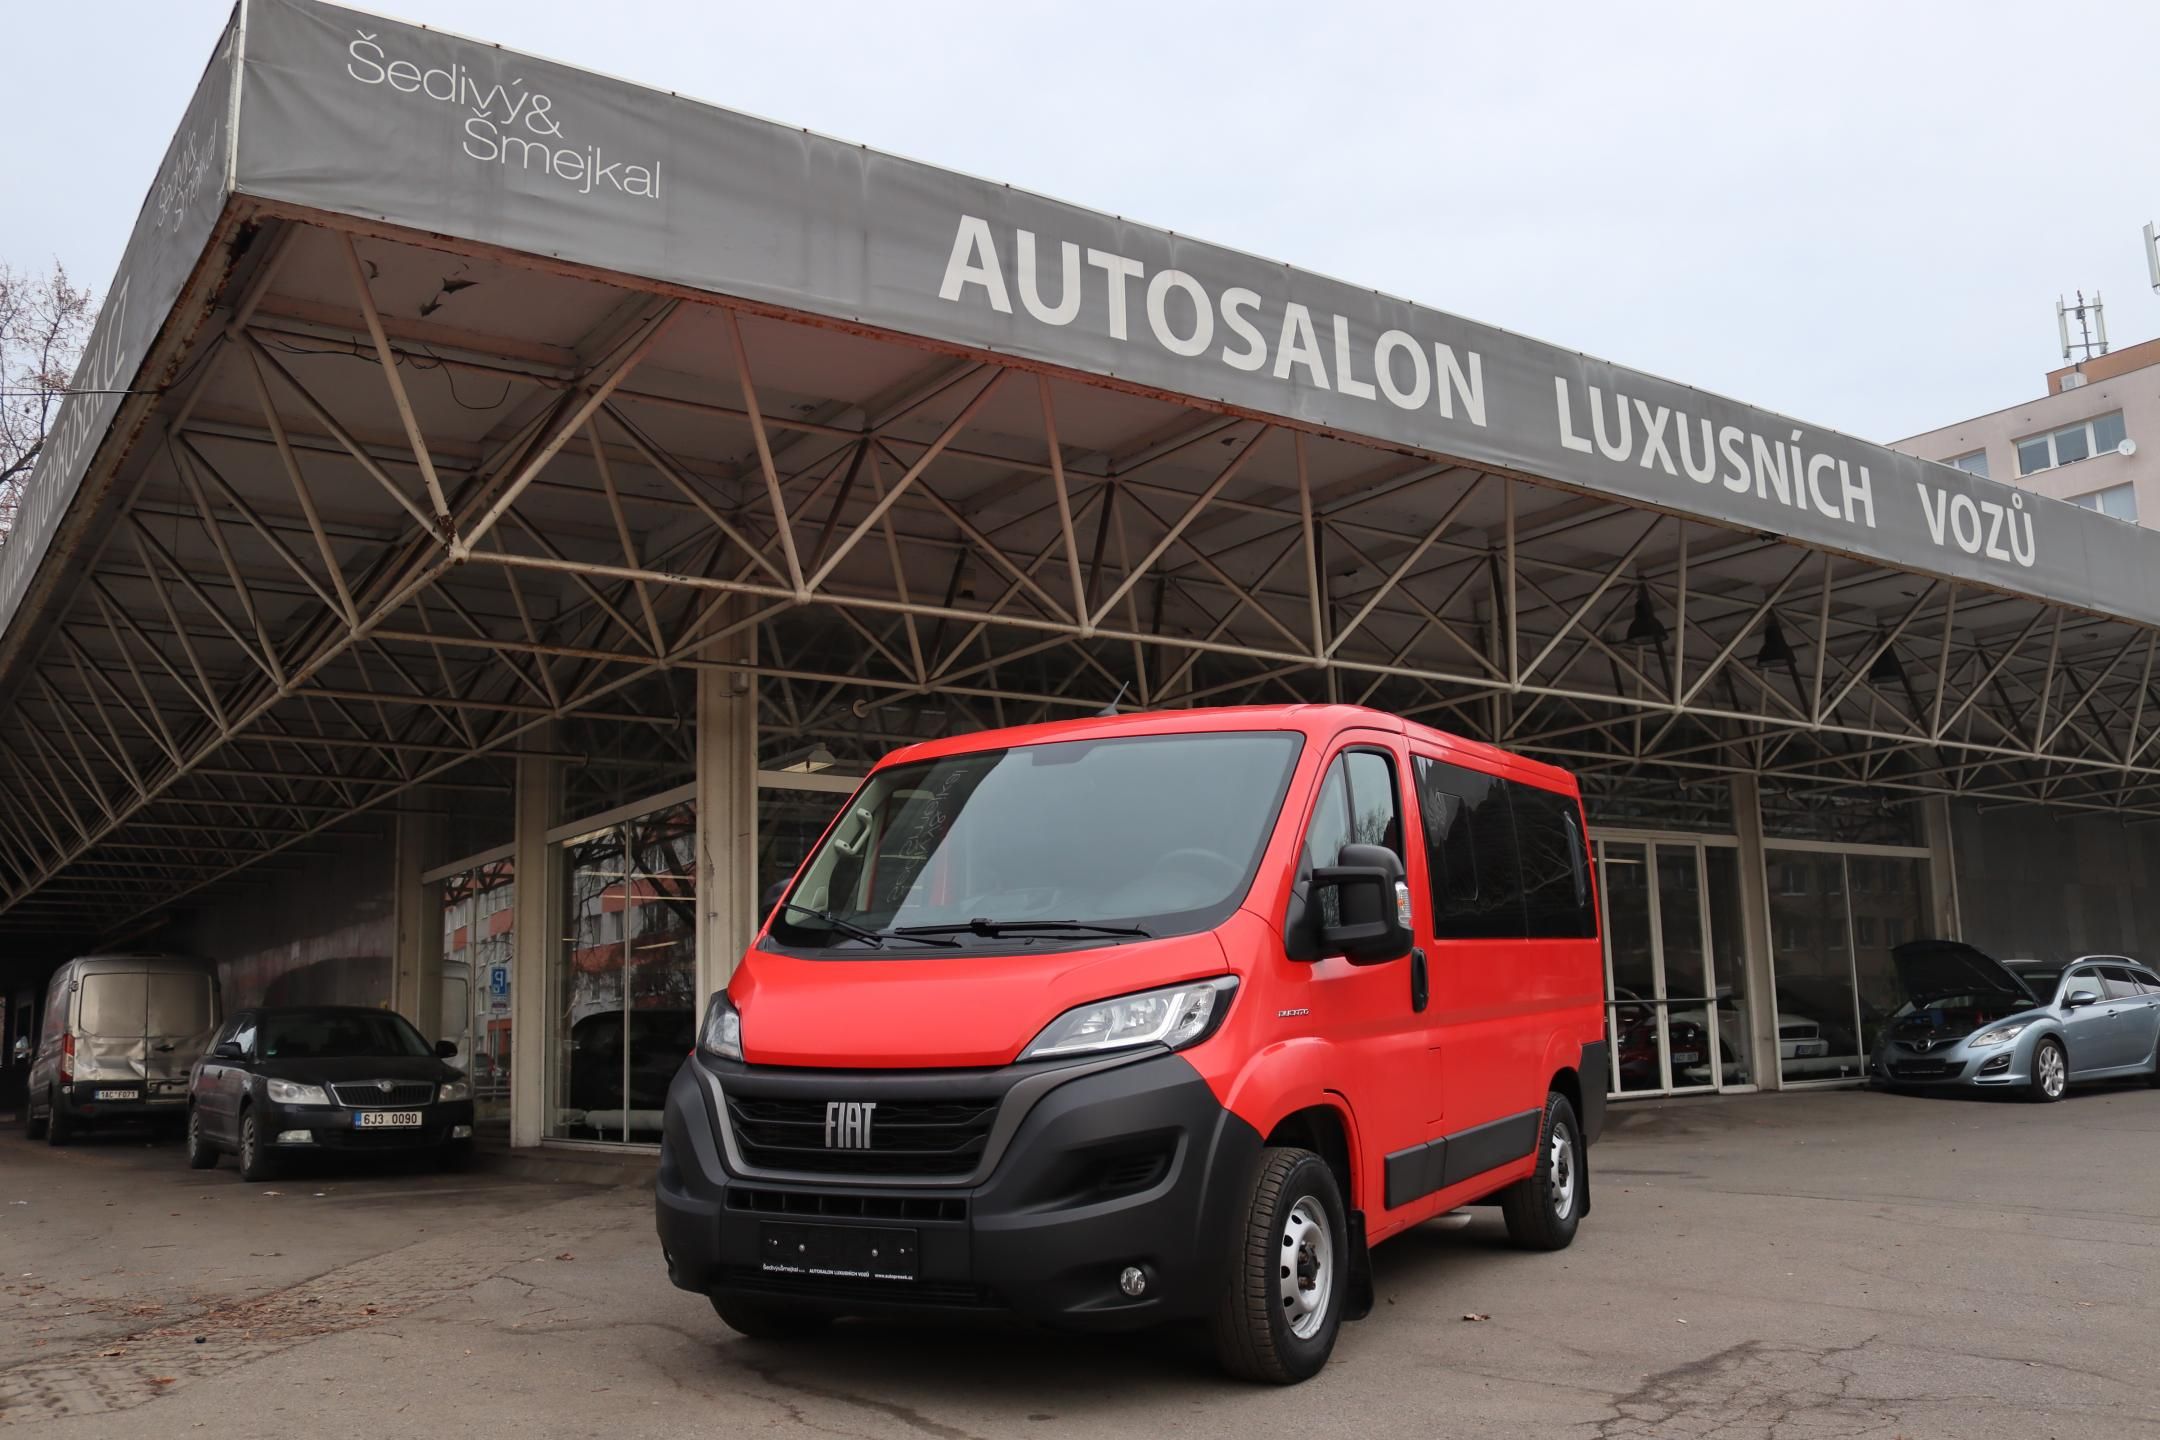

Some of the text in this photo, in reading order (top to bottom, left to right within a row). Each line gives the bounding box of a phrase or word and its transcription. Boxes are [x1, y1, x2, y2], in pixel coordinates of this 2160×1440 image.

[463, 106, 661, 199] Šmejkal
[938, 214, 2036, 568] AUTOSALON LUXUSNÍCH VOZŮ
[363, 1113, 418, 1125] 6J3 0090
[825, 1101, 877, 1149] FIAT
